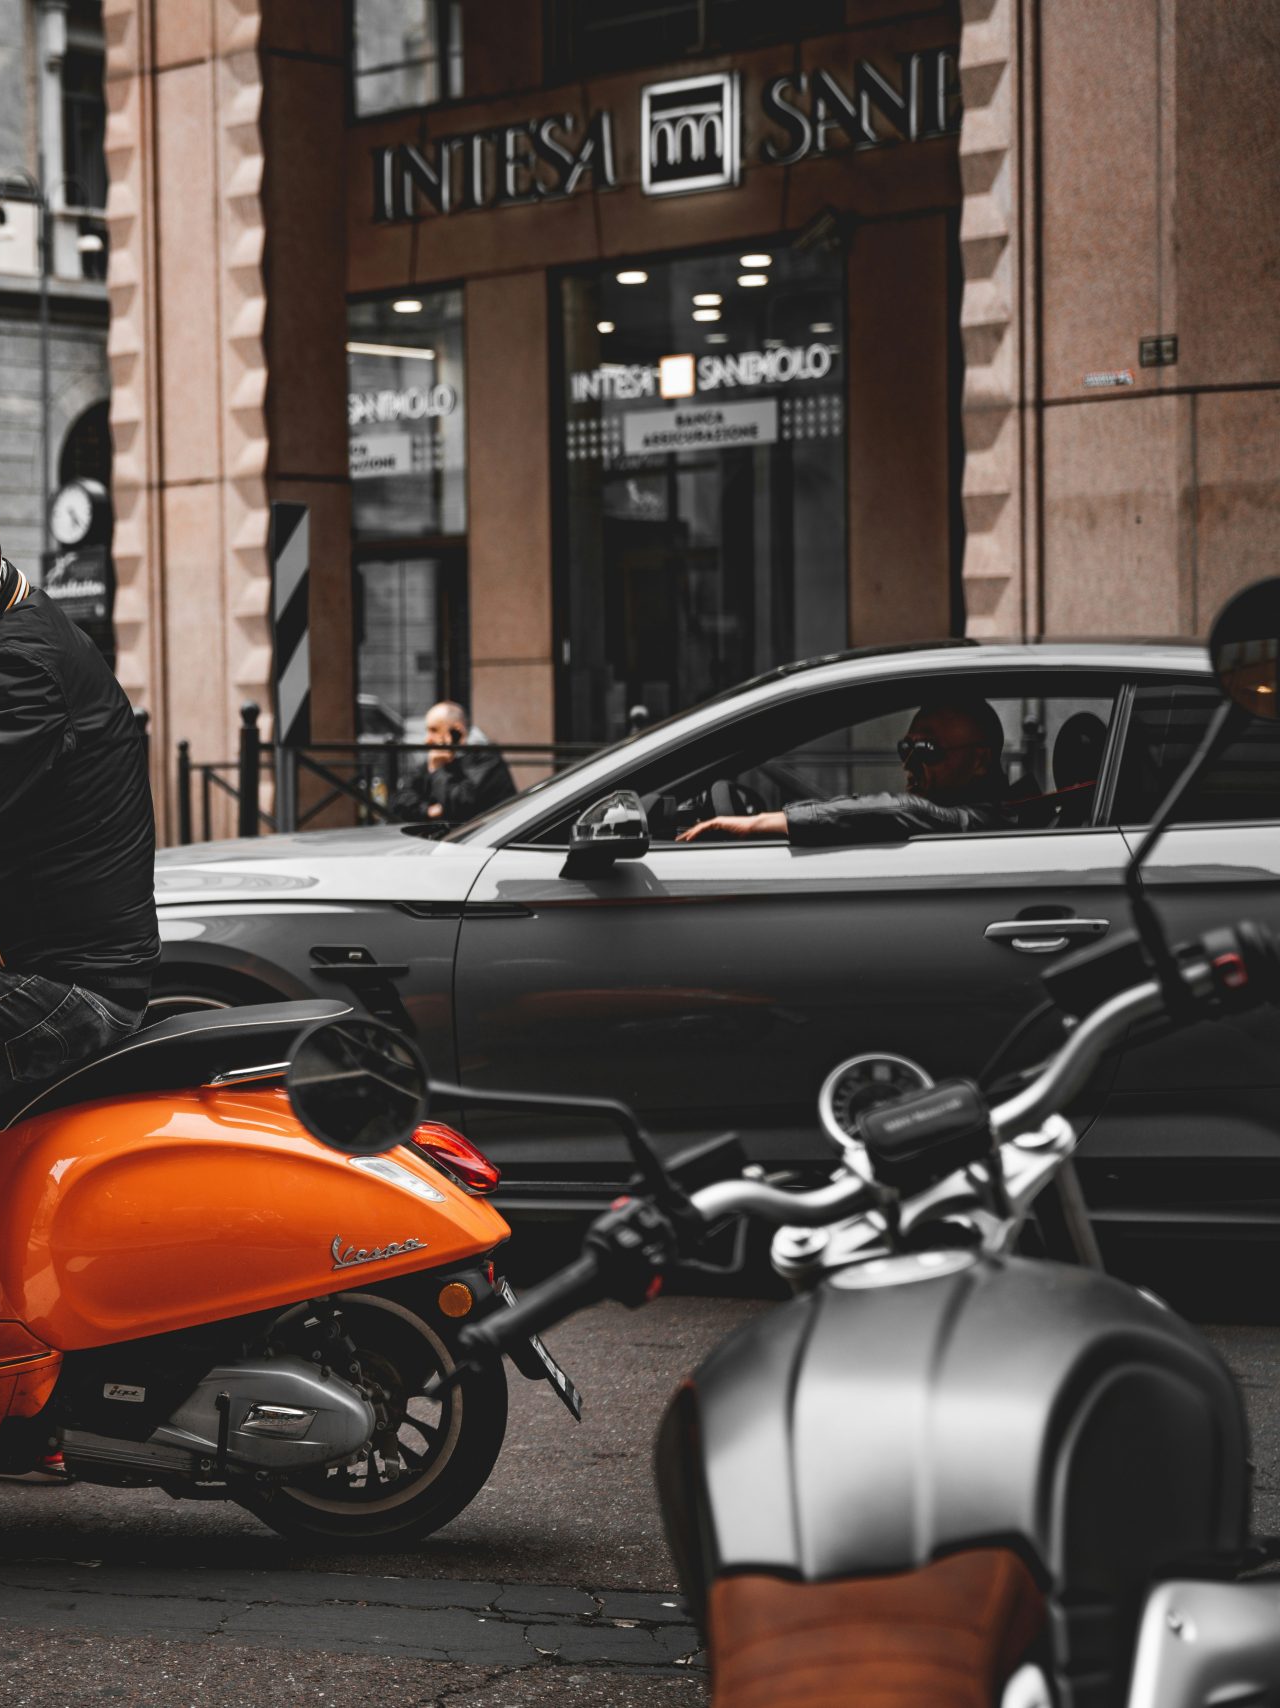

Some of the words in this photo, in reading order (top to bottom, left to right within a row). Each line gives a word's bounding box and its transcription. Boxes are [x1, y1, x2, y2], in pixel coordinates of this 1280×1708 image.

[373, 111, 618, 224] INTESA
[571, 363, 656, 403] INTESA
[332, 1233, 428, 1270] Vespa
